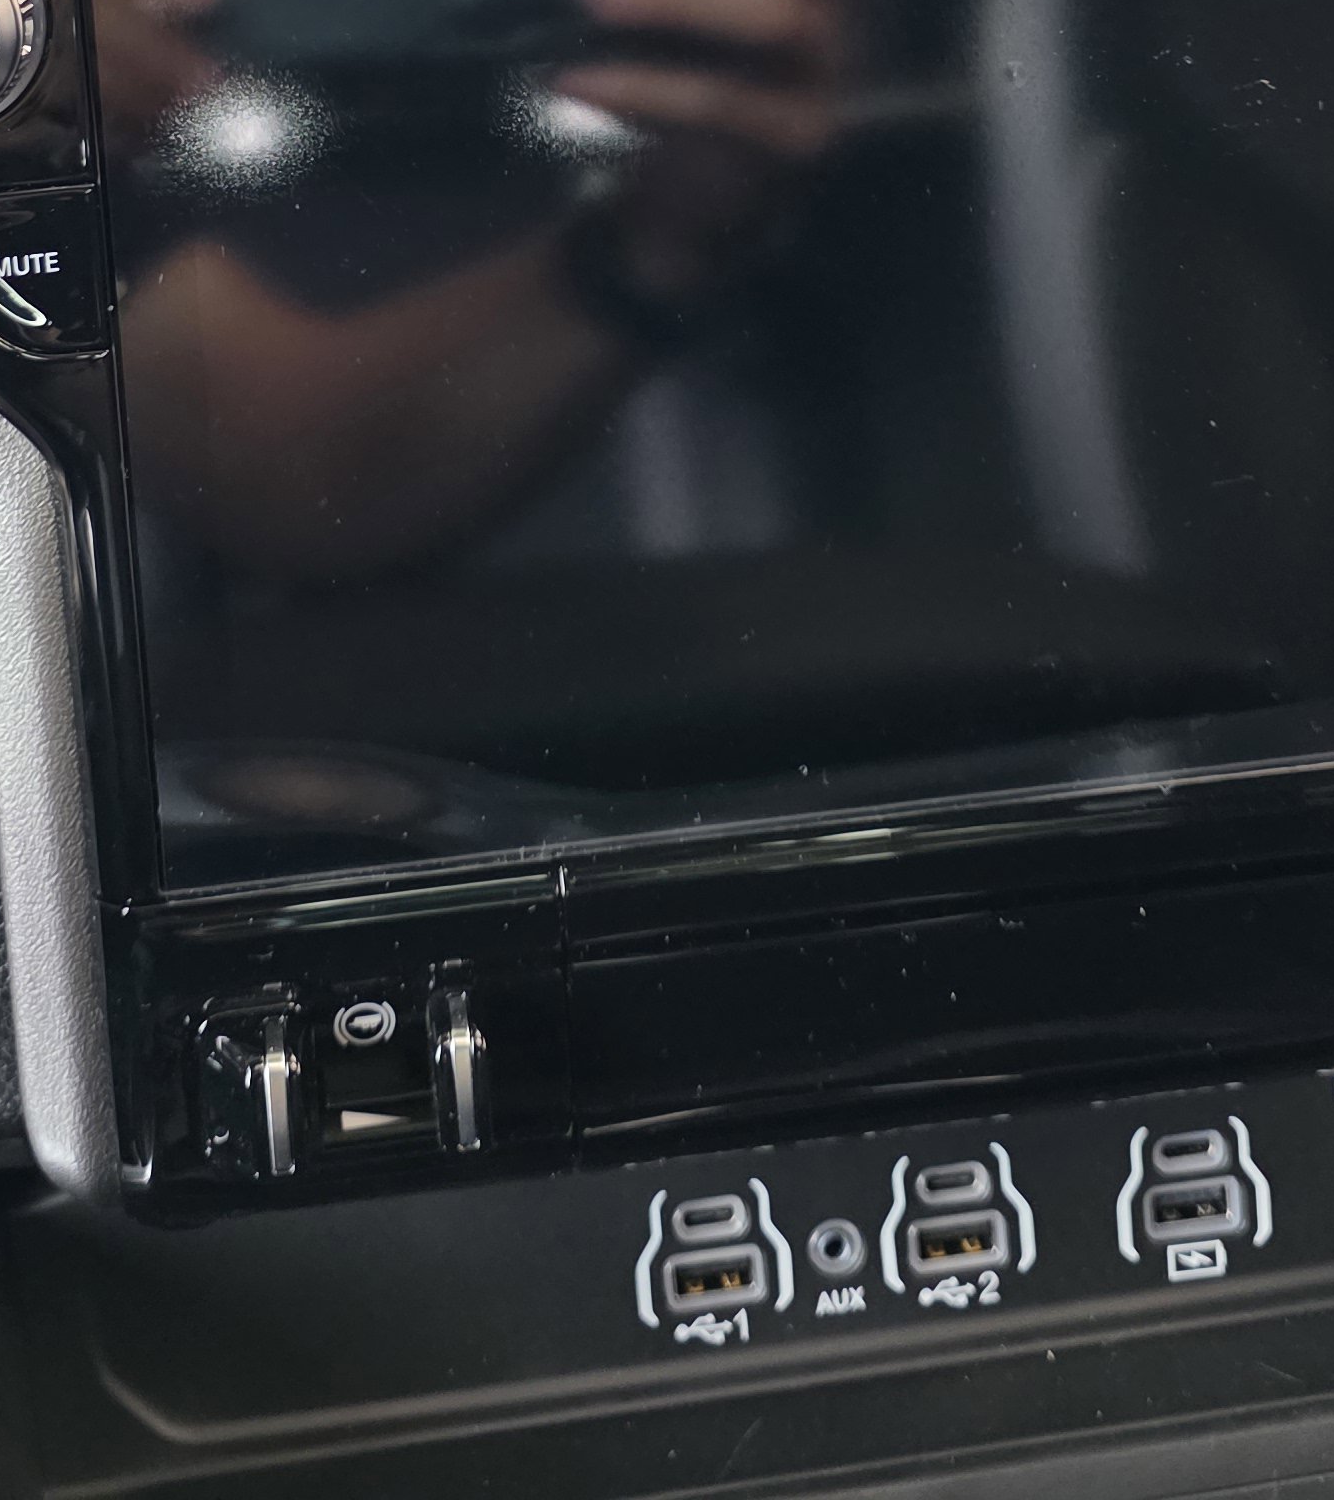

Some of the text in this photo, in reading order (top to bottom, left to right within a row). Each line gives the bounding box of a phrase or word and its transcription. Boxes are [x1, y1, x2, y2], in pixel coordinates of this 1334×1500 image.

[815, 1286, 866, 1316] AUX
[976, 1271, 1001, 1304] 2
[734, 1310, 750, 1341] 1
